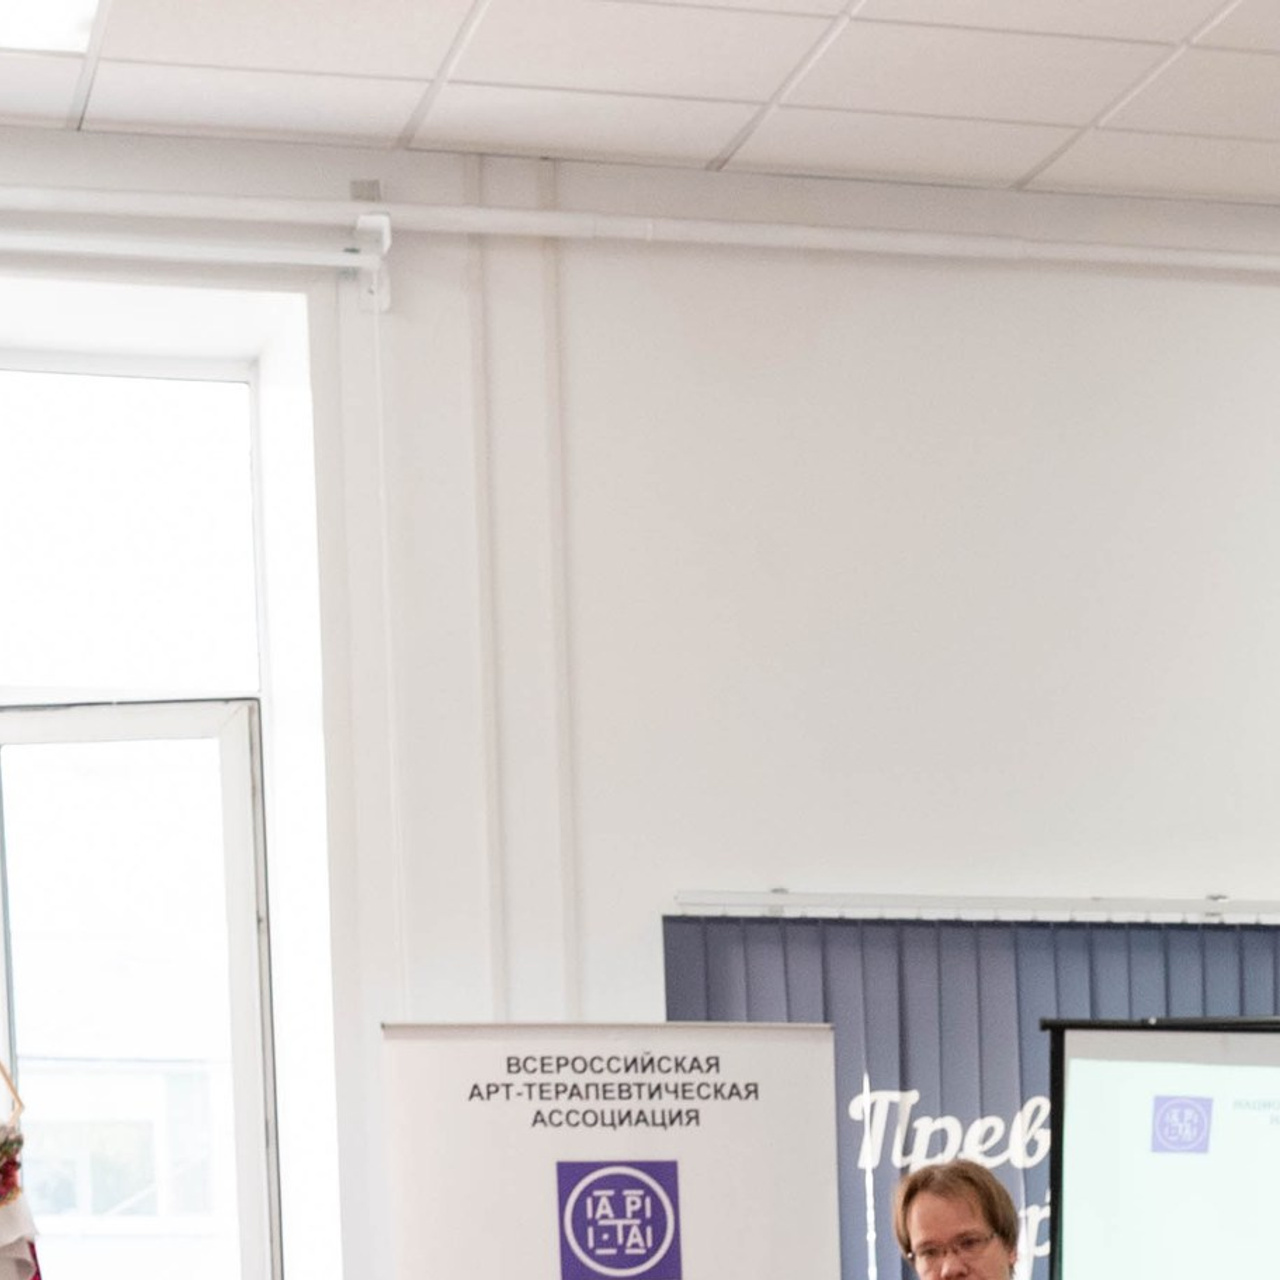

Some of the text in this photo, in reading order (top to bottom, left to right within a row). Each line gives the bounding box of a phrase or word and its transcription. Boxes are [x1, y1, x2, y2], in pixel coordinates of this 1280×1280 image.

[505, 1052, 721, 1075] ВСЕРОССИЙСКАЯ
[467, 1082, 760, 1102] АРТ-ТЕРАПЕВТИЧЕСКАЯ
[531, 1108, 701, 1131] АССОЦИАЦИЯ
[848, 1088, 1051, 1172] Прев
